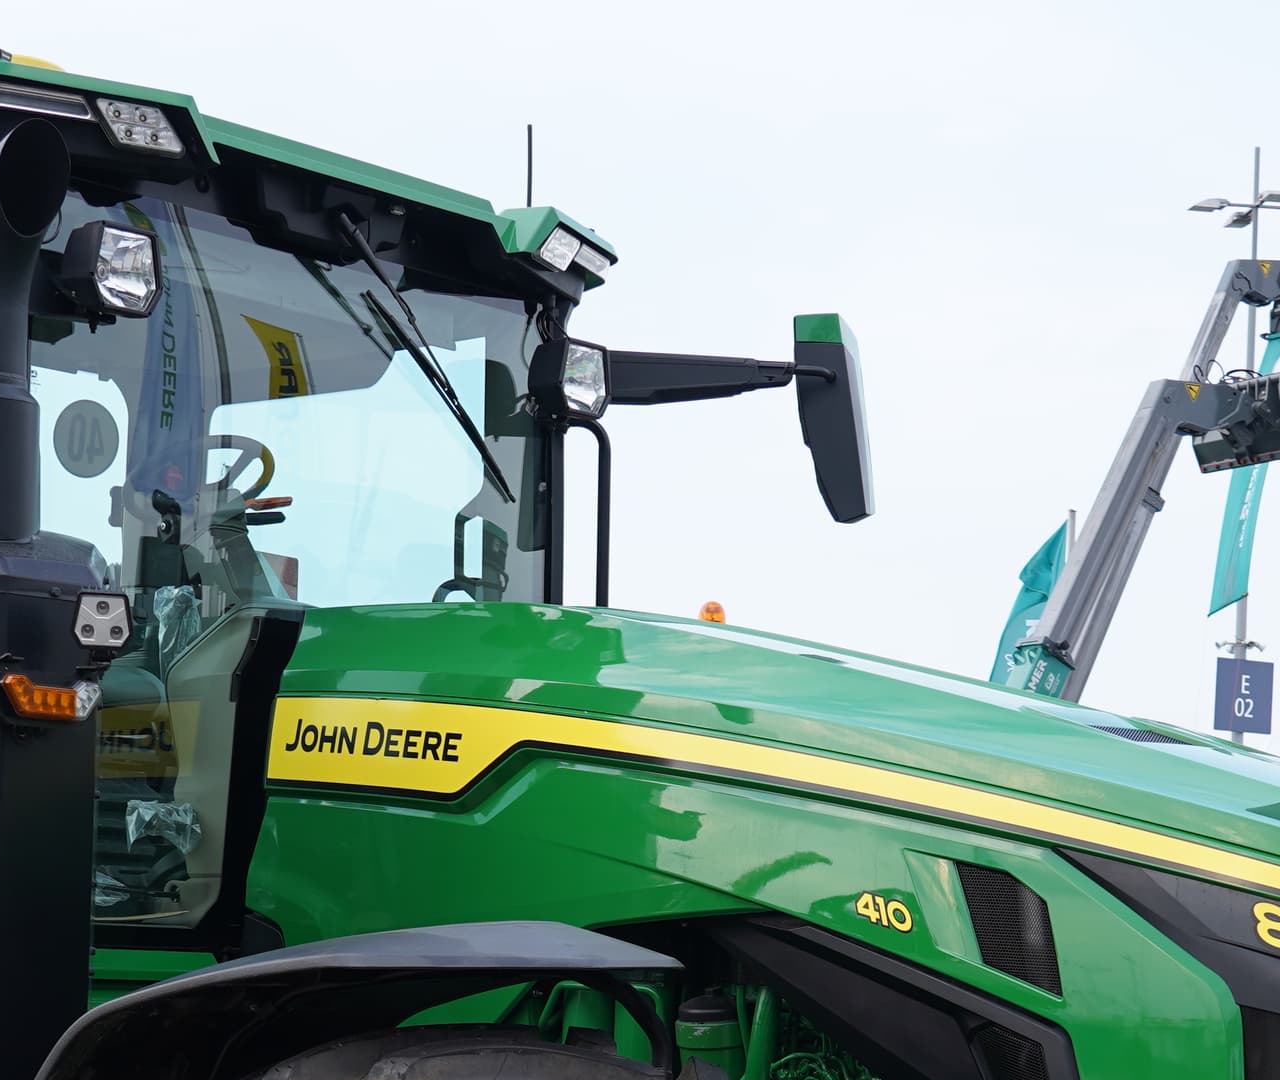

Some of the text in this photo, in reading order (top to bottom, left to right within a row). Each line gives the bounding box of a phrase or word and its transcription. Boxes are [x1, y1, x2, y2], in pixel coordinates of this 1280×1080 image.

[1240, 675, 1250, 694] E
[1234, 698, 1254, 718] 02
[285, 717, 463, 763] JOHN DEERE
[855, 890, 913, 934] 410
